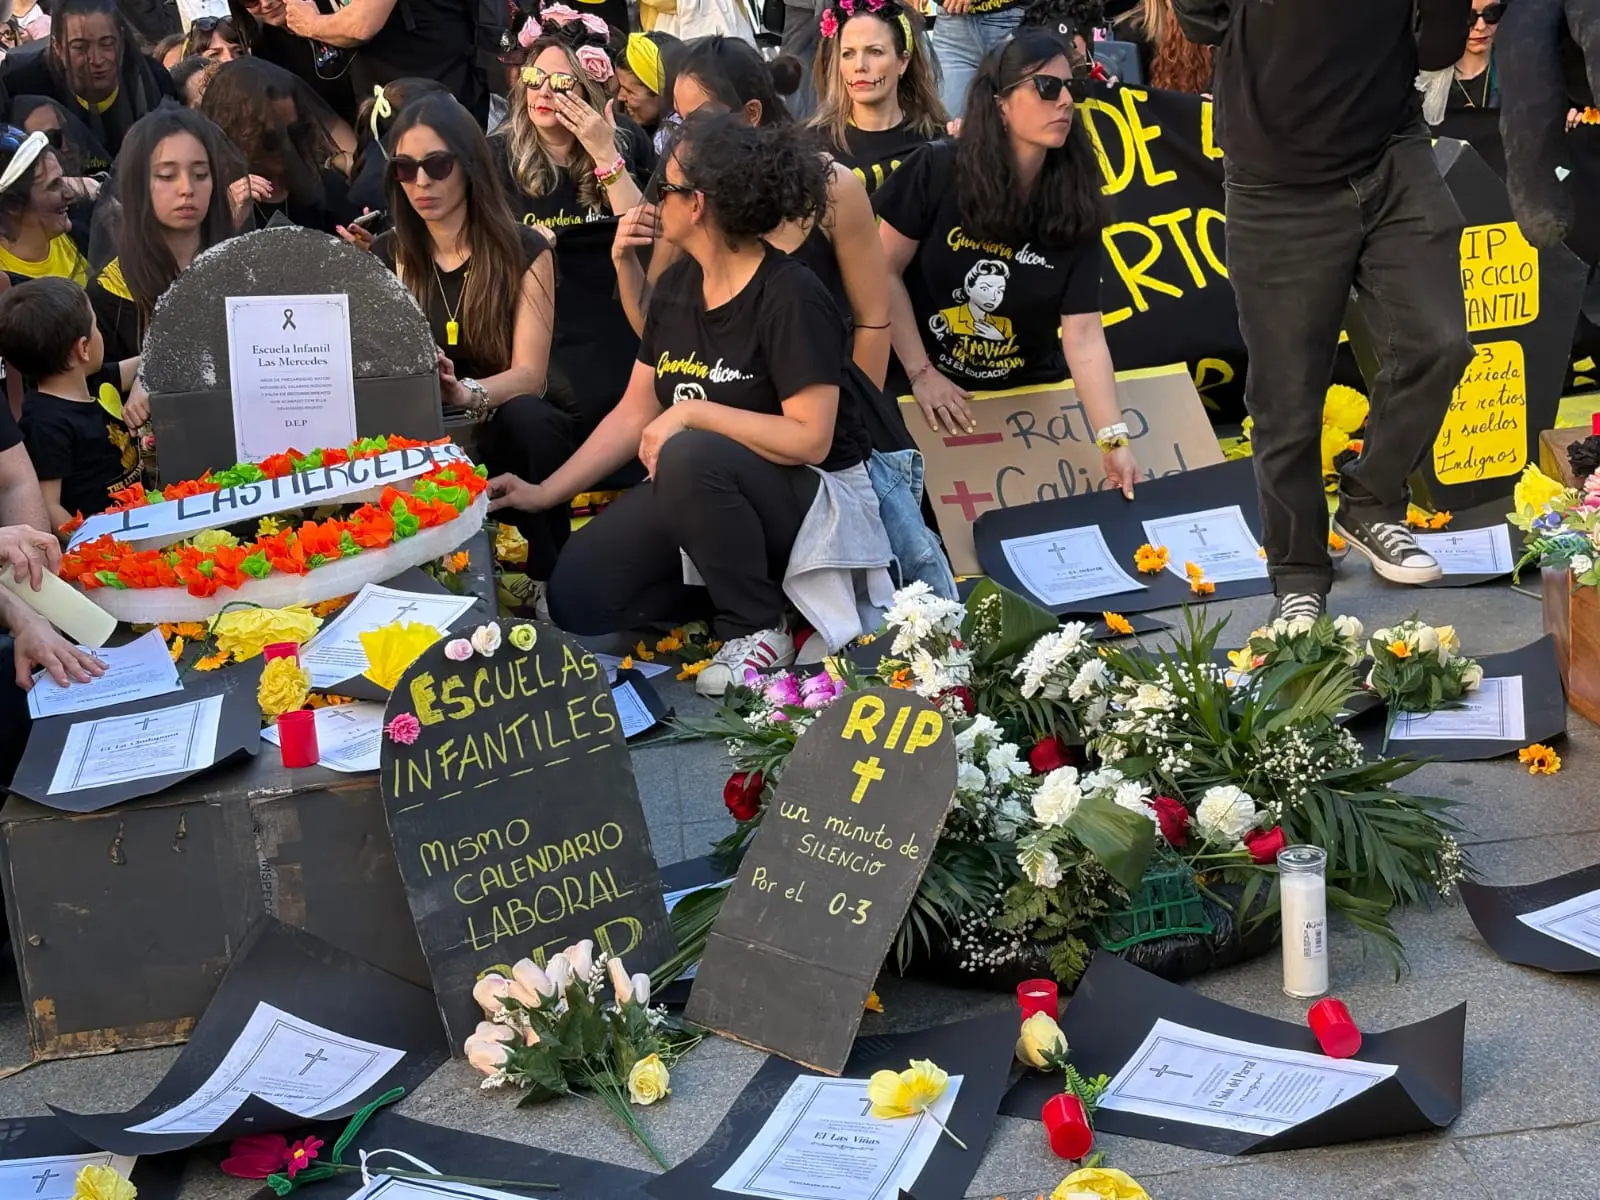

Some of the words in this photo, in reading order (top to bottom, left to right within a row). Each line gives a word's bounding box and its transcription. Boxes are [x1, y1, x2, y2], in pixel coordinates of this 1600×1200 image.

[1073, 87, 1177, 195] DE
[1481, 262, 1533, 287] CICLO
[1465, 292, 1532, 327] ANTIL
[252, 344, 290, 355] Escuela
[293, 343, 330, 354] Infantil
[258, 357, 276, 367] Las
[279, 355, 328, 367] Mercedes
[709, 357, 754, 383] dicen...
[1449, 401, 1467, 412] or
[1476, 383, 1526, 409] ratios
[1442, 429, 1451, 447] y
[1460, 410, 1518, 437] sueldos
[410, 645, 598, 727] ESCUELAS
[394, 692, 617, 798] INFANTILES
[841, 694, 944, 754] RIP
[420, 818, 531, 876] MISMO
[780, 801, 810, 823] un
[824, 816, 894, 850] minuto
[899, 833, 920, 860] de
[454, 822, 624, 905] CALENDARIO
[468, 867, 634, 951] LABORAL
[751, 867, 778, 894] Por
[829, 892, 873, 925] 0-3
[830, 1133, 848, 1142] Las
